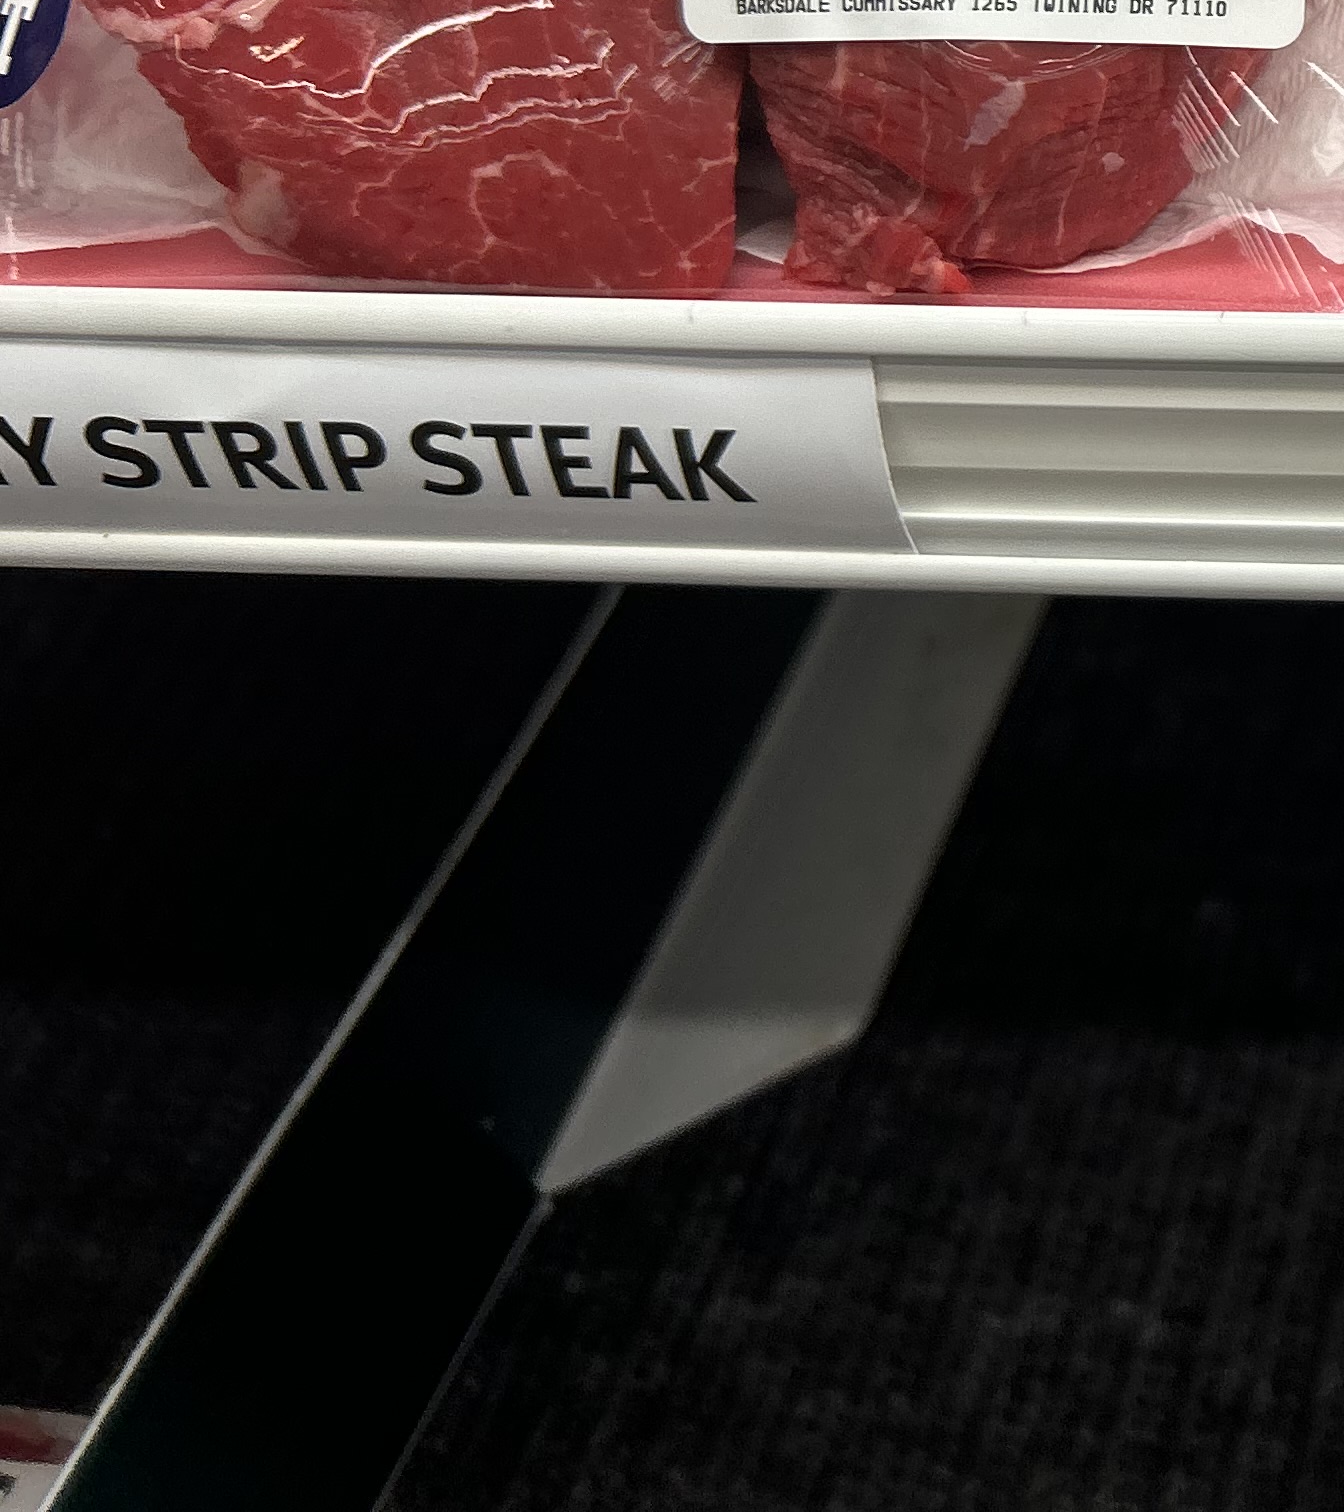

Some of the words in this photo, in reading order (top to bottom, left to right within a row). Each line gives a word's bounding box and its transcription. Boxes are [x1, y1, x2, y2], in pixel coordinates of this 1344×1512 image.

[1167, 0, 1226, 16] 71110
[0, 416, 56, 487] Y
[82, 415, 390, 493] STRIP
[409, 420, 759, 504] STEAK
